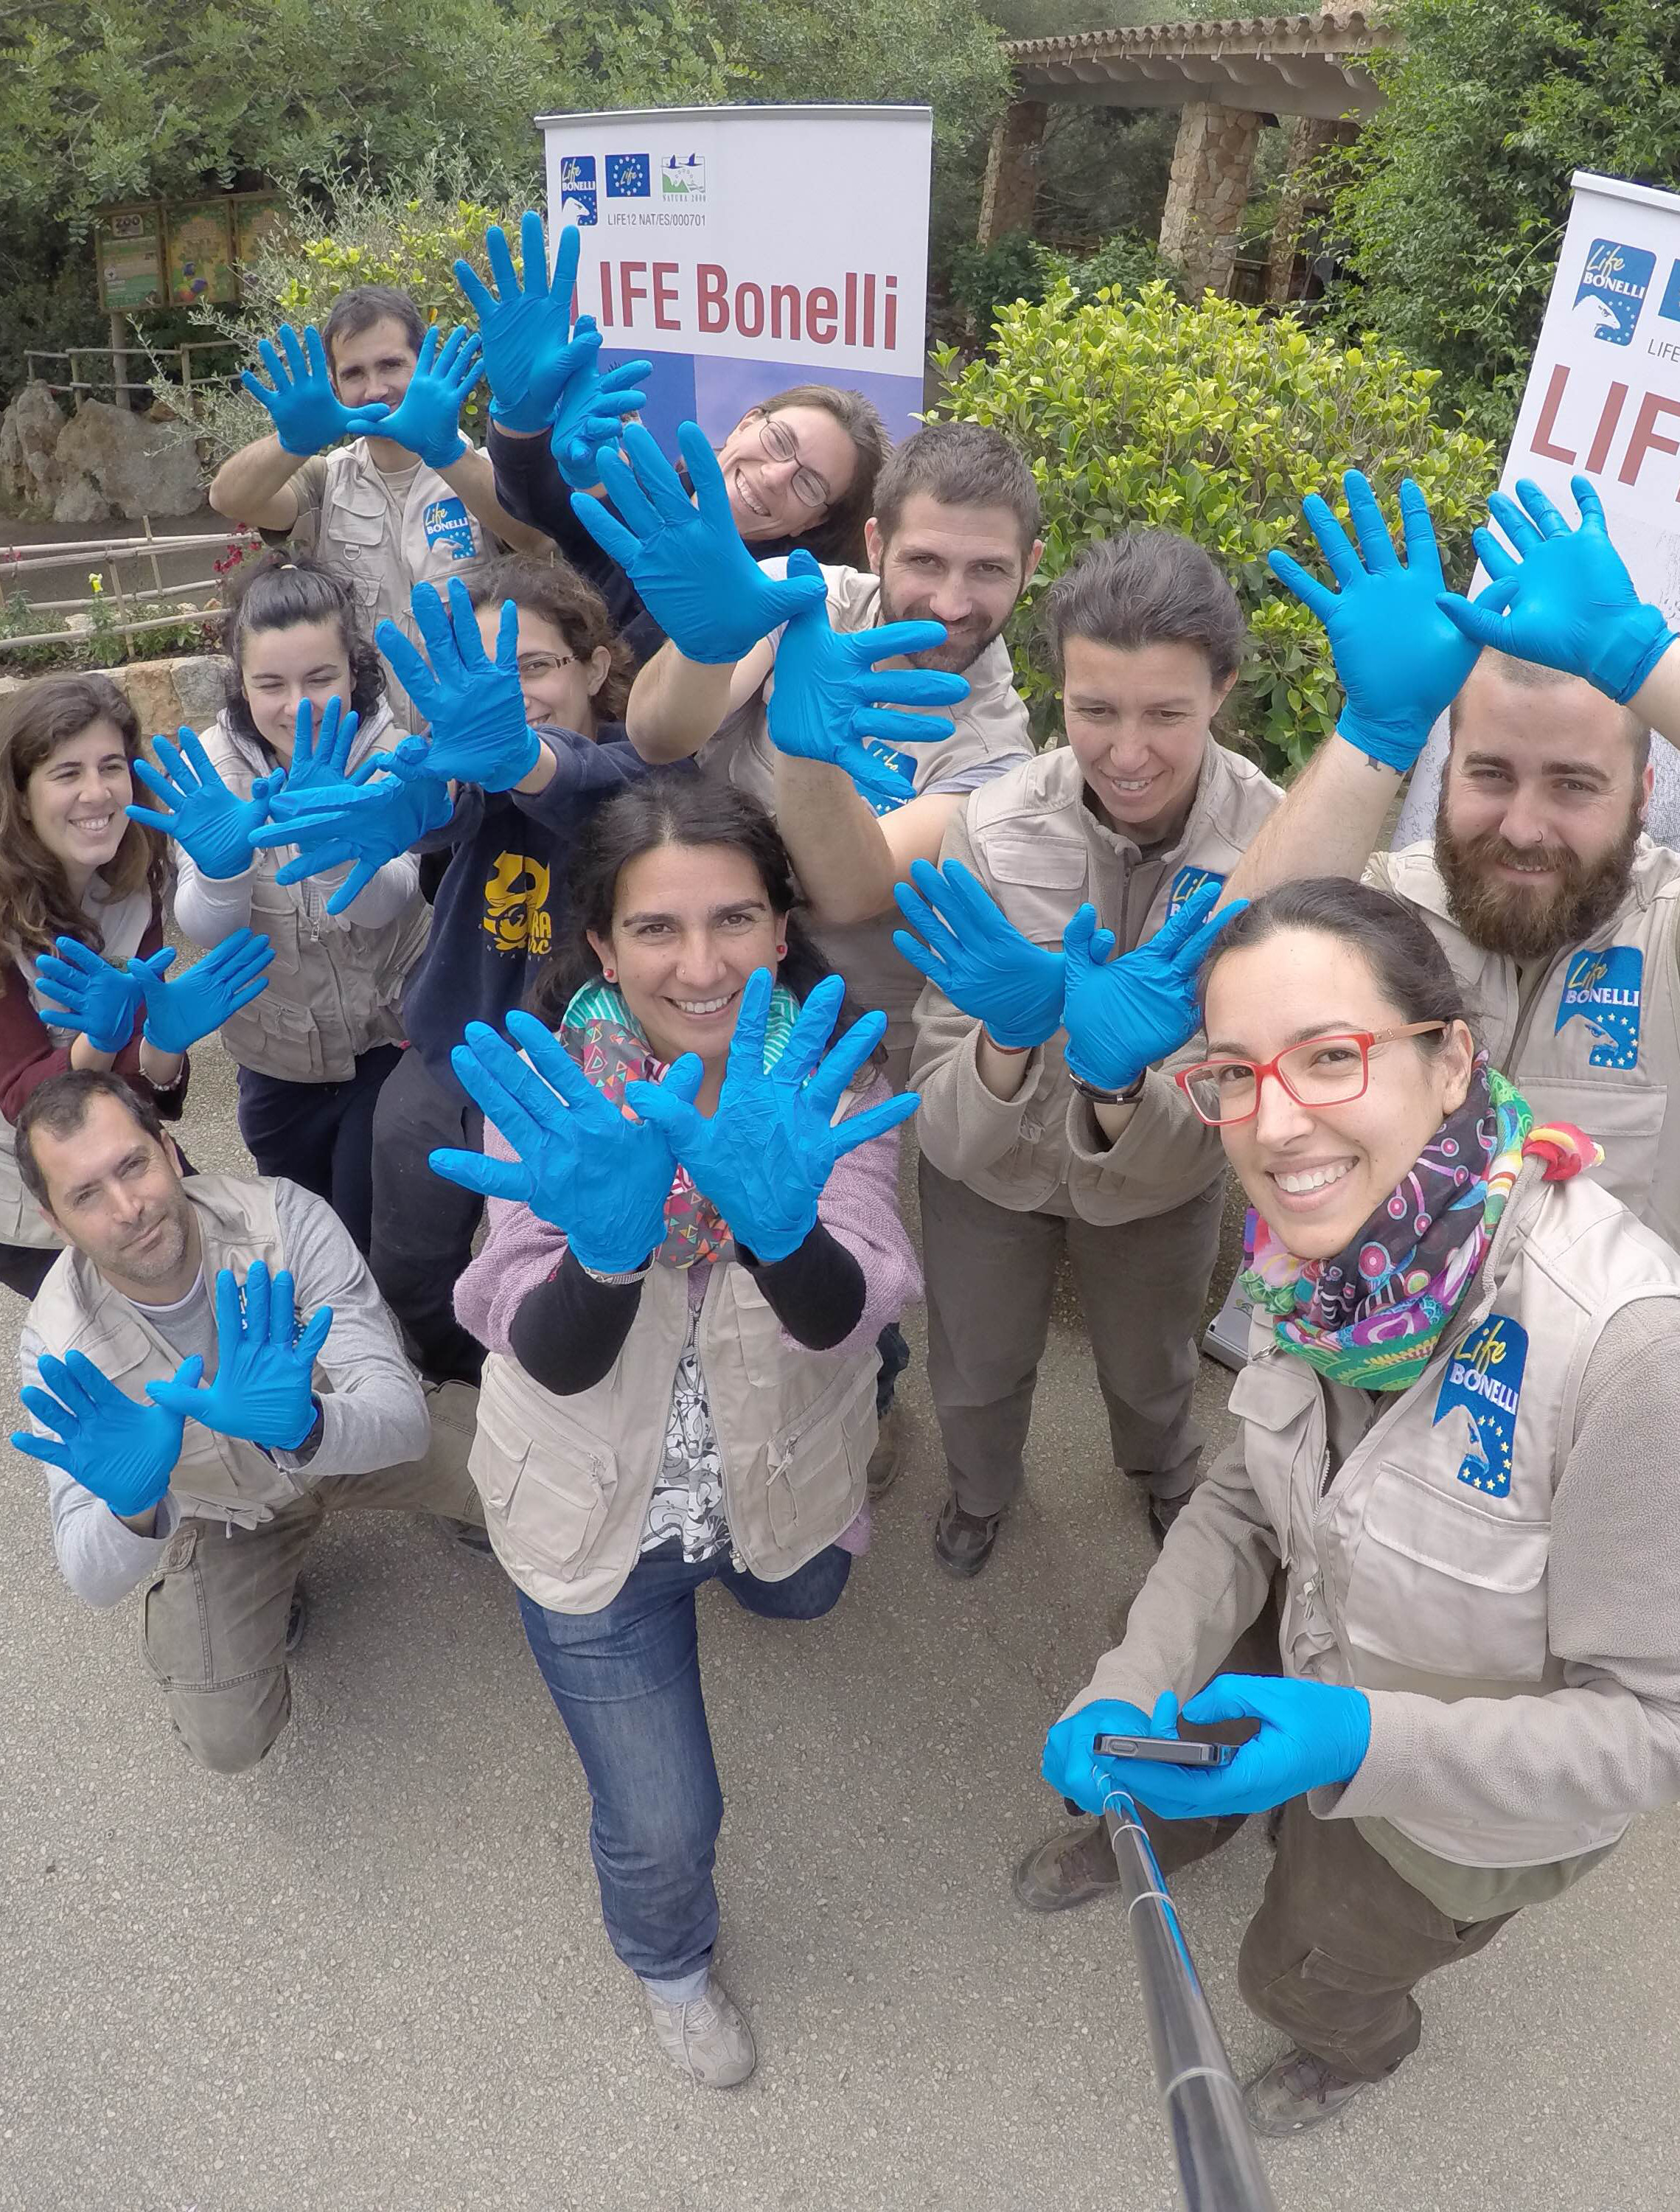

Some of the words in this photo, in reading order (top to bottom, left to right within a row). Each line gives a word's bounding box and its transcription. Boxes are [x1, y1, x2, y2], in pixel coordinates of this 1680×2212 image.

[562, 158, 582, 184] Life
[618, 166, 638, 185] Life
[562, 180, 596, 192] BONELLI
[115, 215, 140, 228] ZOO
[607, 213, 637, 226] LIFE12
[639, 214, 705, 227] NAT/ES/000701
[1586, 245, 1625, 278] Life
[1583, 271, 1646, 299] BONELLI
[571, 261, 681, 332] IFE
[697, 263, 899, 351] Bonelli
[1530, 364, 1680, 504] LIF
[425, 502, 447, 526] Life
[426, 517, 469, 535] BONELLI
[1567, 952, 1608, 991] Life
[1565, 987, 1640, 1007] BONELLI
[1454, 1319, 1508, 1379] Life
[1449, 1363, 1519, 1416] BONELLI
